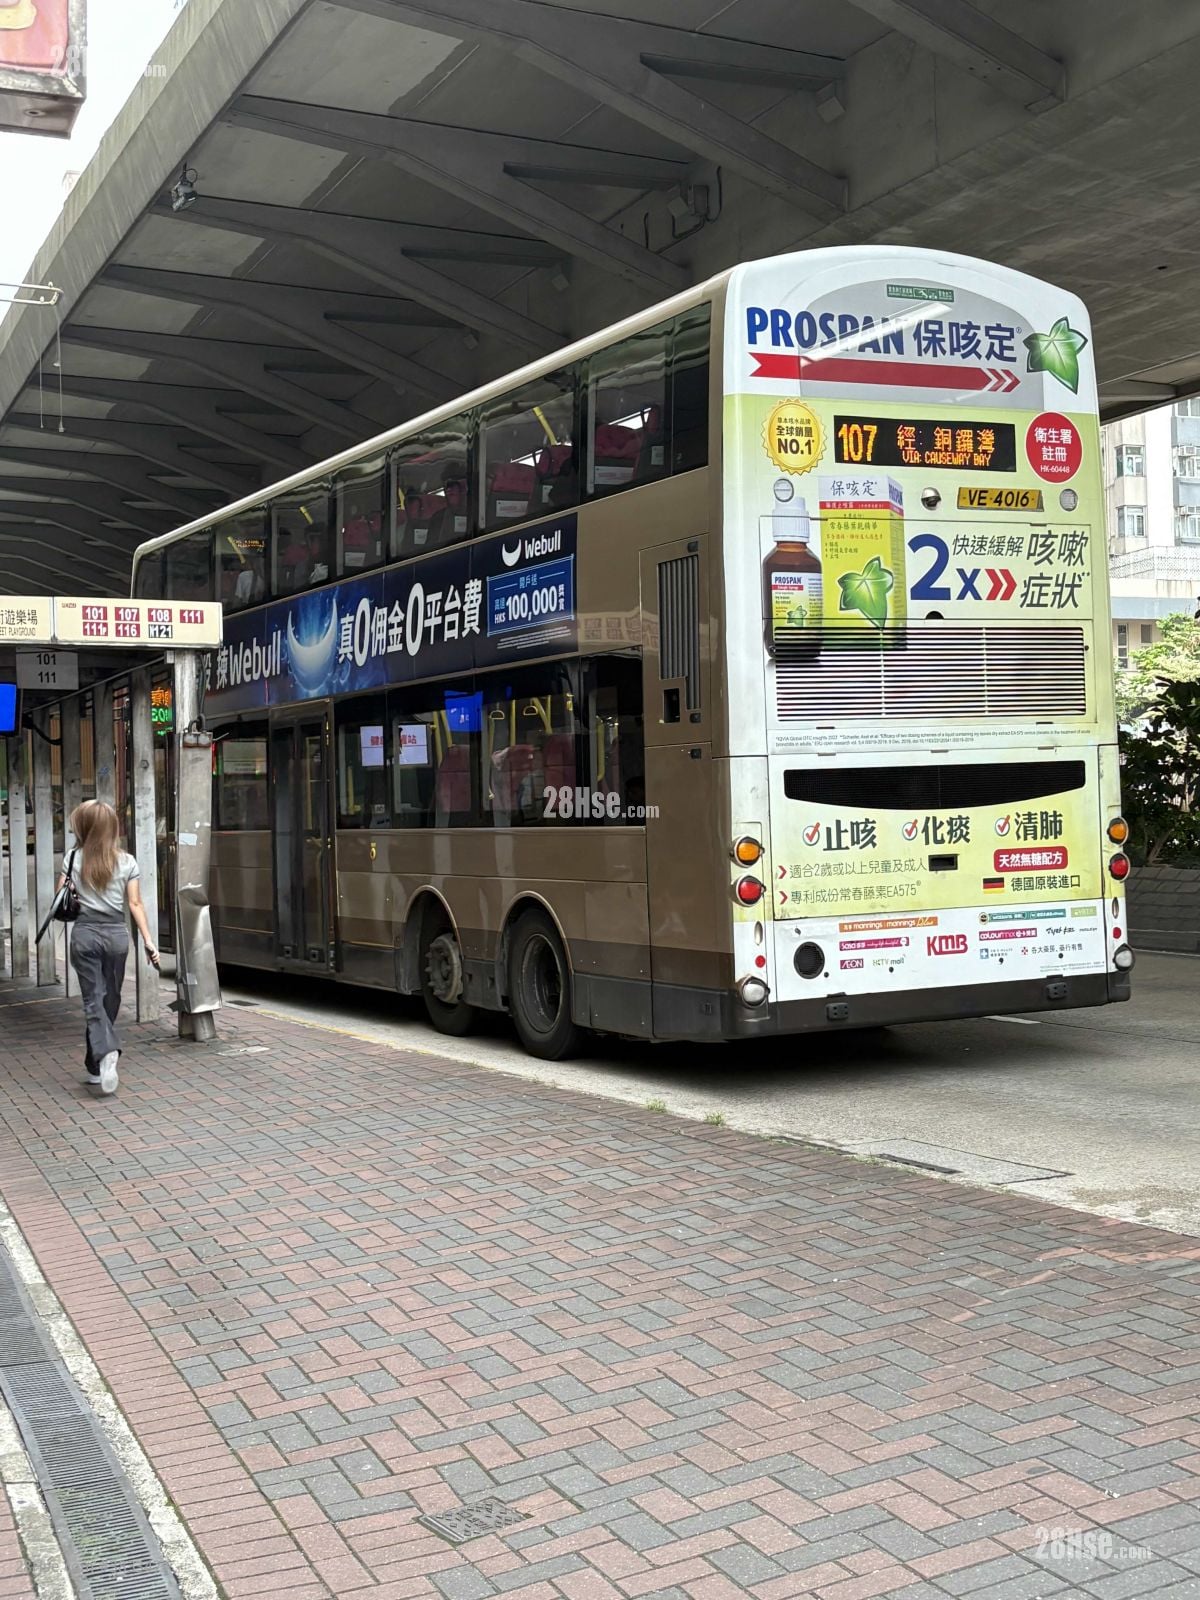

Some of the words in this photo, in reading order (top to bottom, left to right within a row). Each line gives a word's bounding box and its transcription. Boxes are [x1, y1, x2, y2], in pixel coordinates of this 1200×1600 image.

[746, 306, 904, 356] PROSPAN
[776, 425, 813, 437] 全球銷量
[934, 426, 995, 453] 銅鑼灣
[1034, 427, 1072, 444] 衛生署
[837, 423, 878, 462] 107
[902, 451, 922, 464] VIA:
[925, 451, 970, 466] CAUSEWAY
[973, 454, 992, 467] BAY
[1042, 445, 1067, 462] 註冊
[1040, 465, 1070, 473] HK-60448
[968, 489, 988, 506] VE
[993, 490, 1029, 507] 4016
[525, 530, 561, 560] Webull
[952, 534, 1024, 557] 快速緩解
[1026, 529, 1089, 567] 咳嗽
[1020, 571, 1083, 609] 症狀
[506, 585, 557, 621] 100,000
[85, 607, 105, 619] 101
[119, 609, 137, 621] 107
[151, 610, 170, 622] 108
[183, 611, 201, 623] 111
[118, 624, 137, 636] 116
[37, 654, 56, 666] 101
[38, 672, 56, 684] 111
[921, 815, 971, 845] 化痰
[1014, 810, 1063, 841] 清肺
[822, 818, 877, 852] 止咳
[999, 851, 1063, 868] 天然無糖配方
[1011, 875, 1081, 892] 德國原裝進口
[927, 933, 968, 956] KMB
